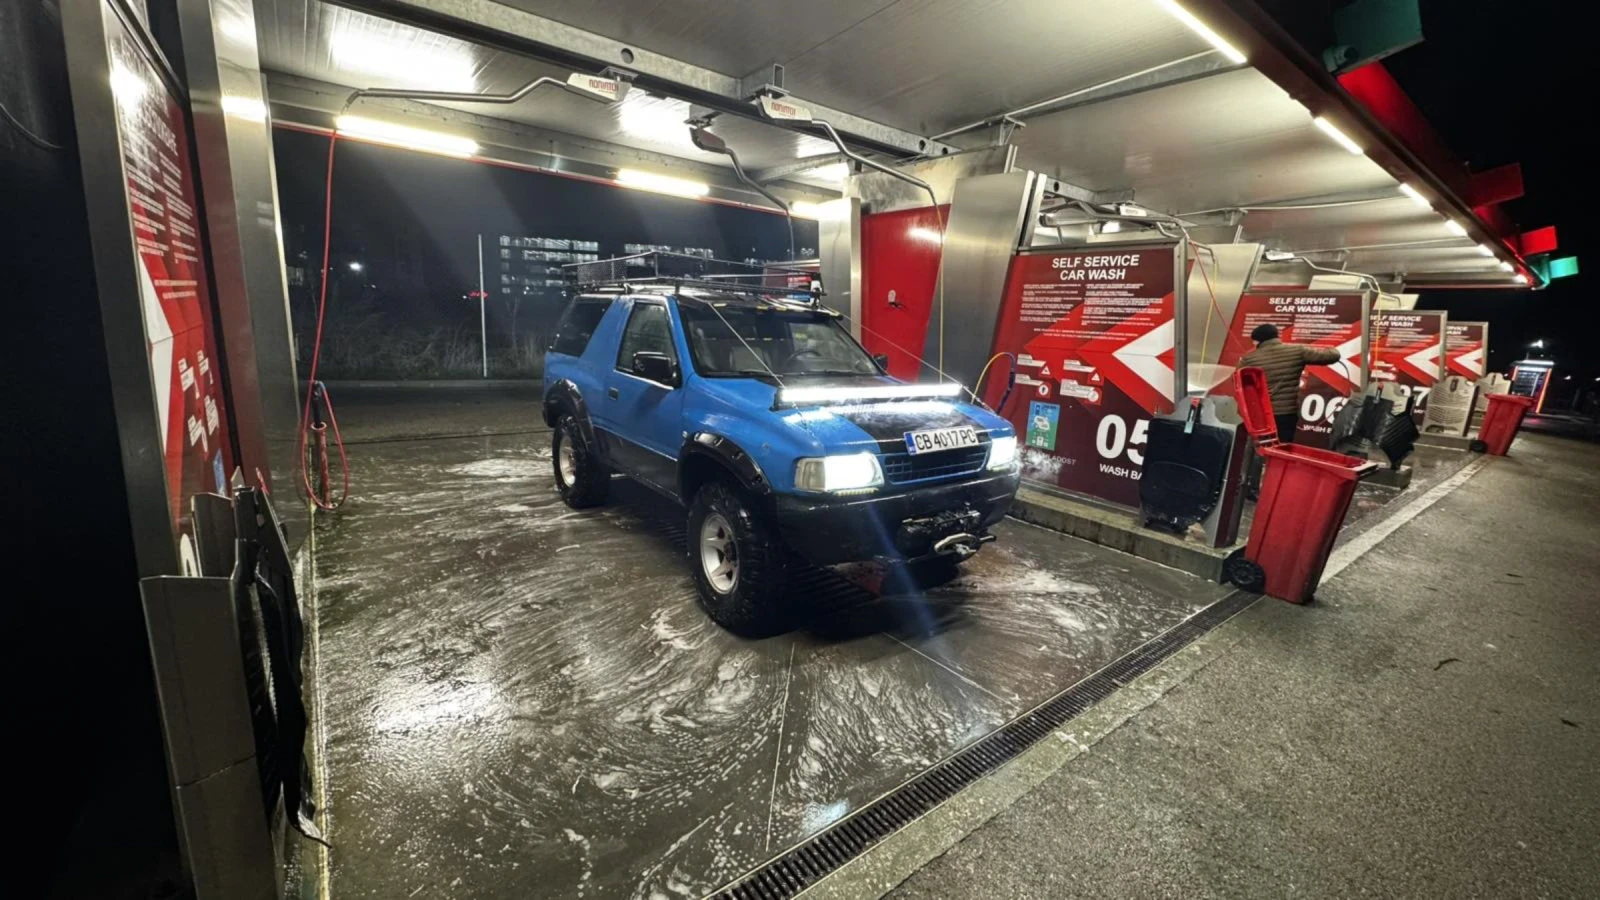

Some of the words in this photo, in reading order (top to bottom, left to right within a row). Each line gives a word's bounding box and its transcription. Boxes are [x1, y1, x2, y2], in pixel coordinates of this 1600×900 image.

[1052, 257, 1082, 268] SELF
[1084, 254, 1140, 267] SERVICE
[1060, 270, 1085, 280] CAR
[1088, 268, 1126, 280] WASH
[1269, 297, 1293, 305] SELF
[1294, 297, 1337, 305] SERVICE
[1275, 305, 1295, 313] CAR
[1297, 305, 1326, 313] WASH
[1301, 393, 1349, 424] 06
[915, 434, 933, 450] CB
[934, 430, 959, 448] 4017
[959, 429, 976, 445] PC
[1096, 414, 1150, 466] 05
[1099, 463, 1129, 478] WASH
